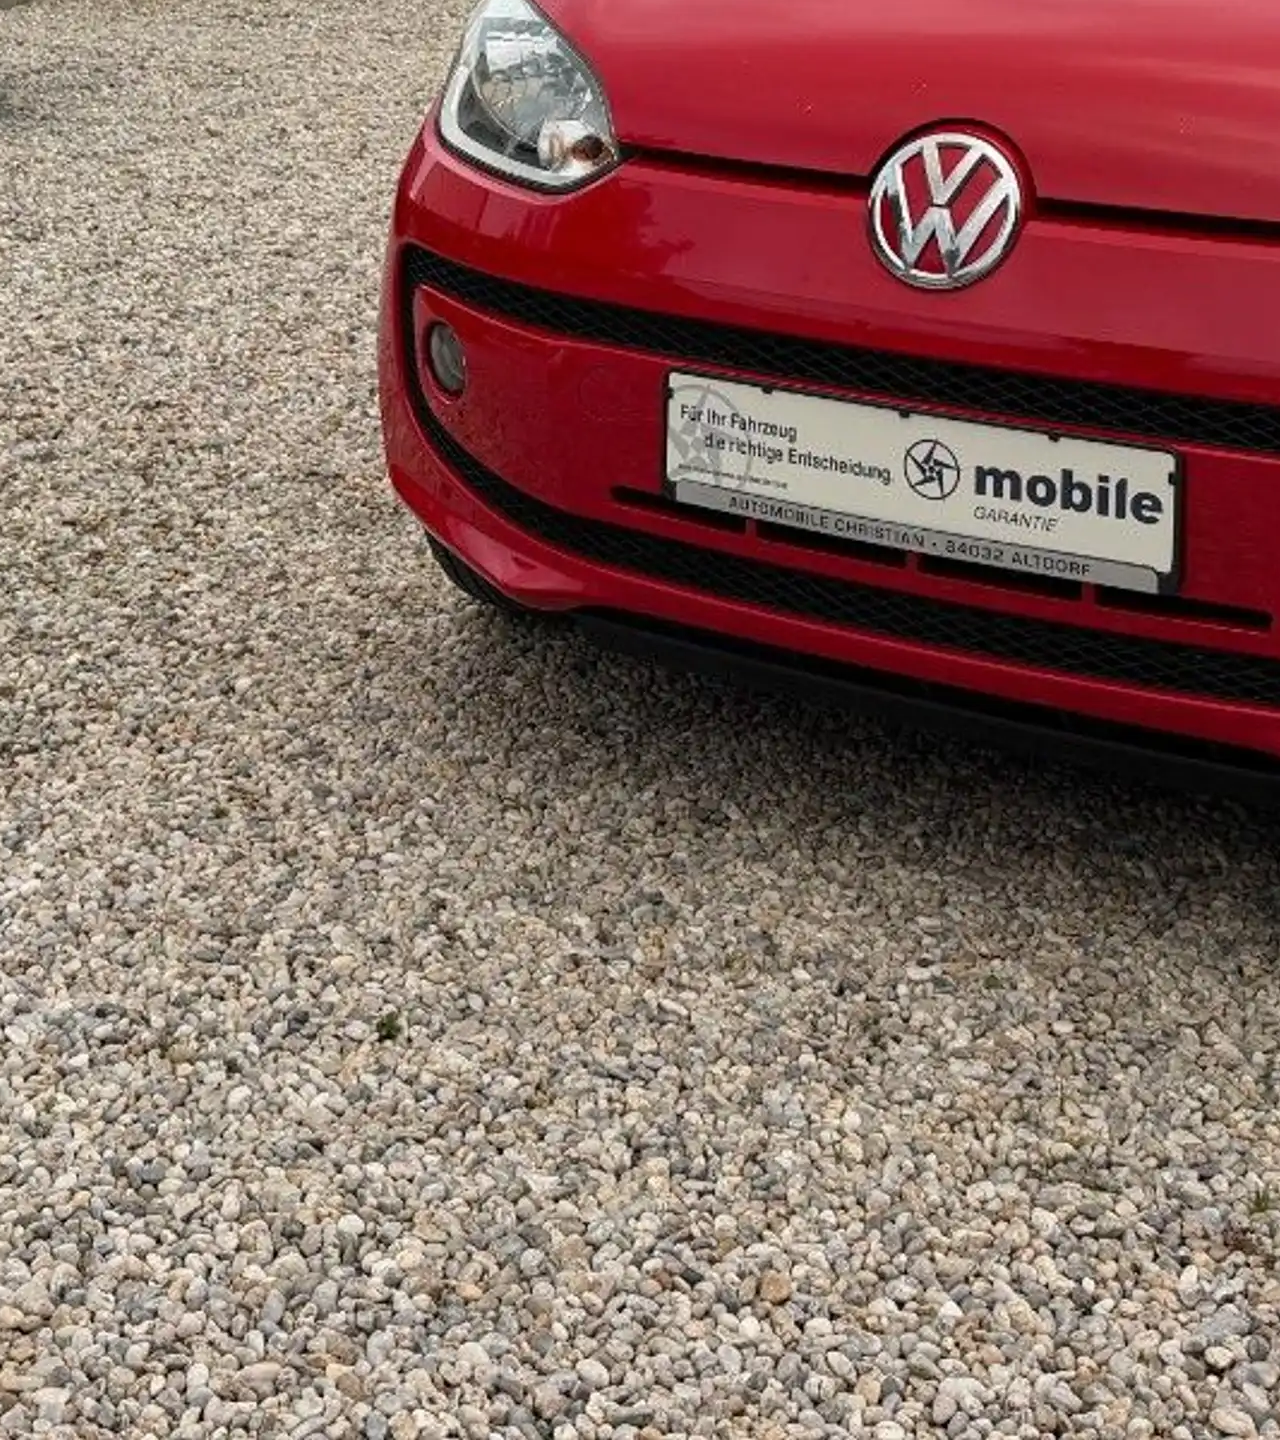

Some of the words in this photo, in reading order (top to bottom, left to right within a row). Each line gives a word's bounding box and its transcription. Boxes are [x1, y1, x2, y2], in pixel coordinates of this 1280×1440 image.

[680, 404, 703, 422] Für
[706, 408, 726, 428] Ihr
[730, 412, 798, 444] Fahrzeug
[704, 433, 725, 451] die
[729, 436, 784, 464] richtige
[974, 464, 1164, 525] mobile
[728, 496, 829, 531] AUTOMOBILE
[833, 517, 925, 550] CHRISTIAN
[1011, 549, 1091, 577] ALTDORF
[973, 505, 1060, 533] GARANTIE
